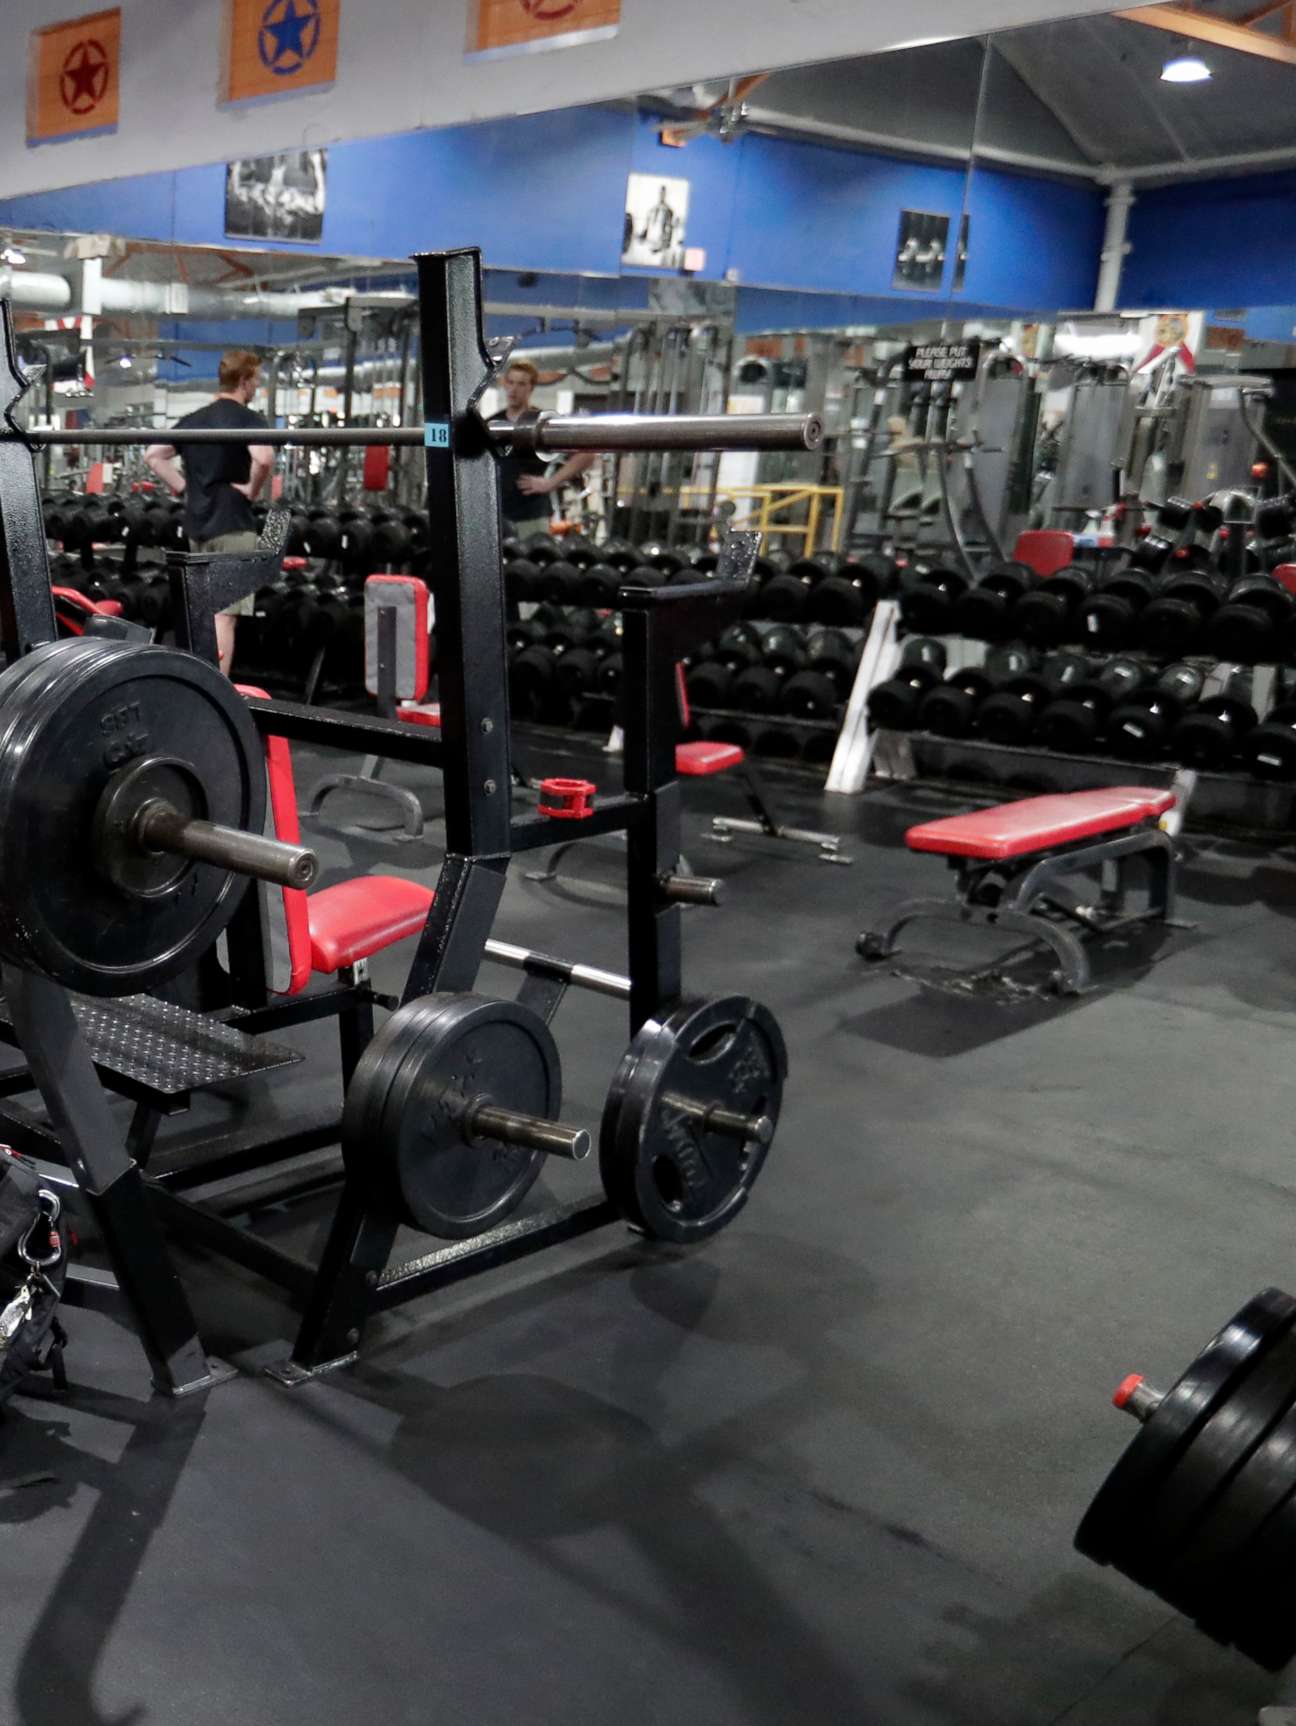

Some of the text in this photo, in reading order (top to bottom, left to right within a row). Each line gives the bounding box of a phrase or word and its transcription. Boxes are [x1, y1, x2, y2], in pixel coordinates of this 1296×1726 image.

[915, 346, 968, 358] PLEASE PUT
[431, 428, 447, 443] 18
